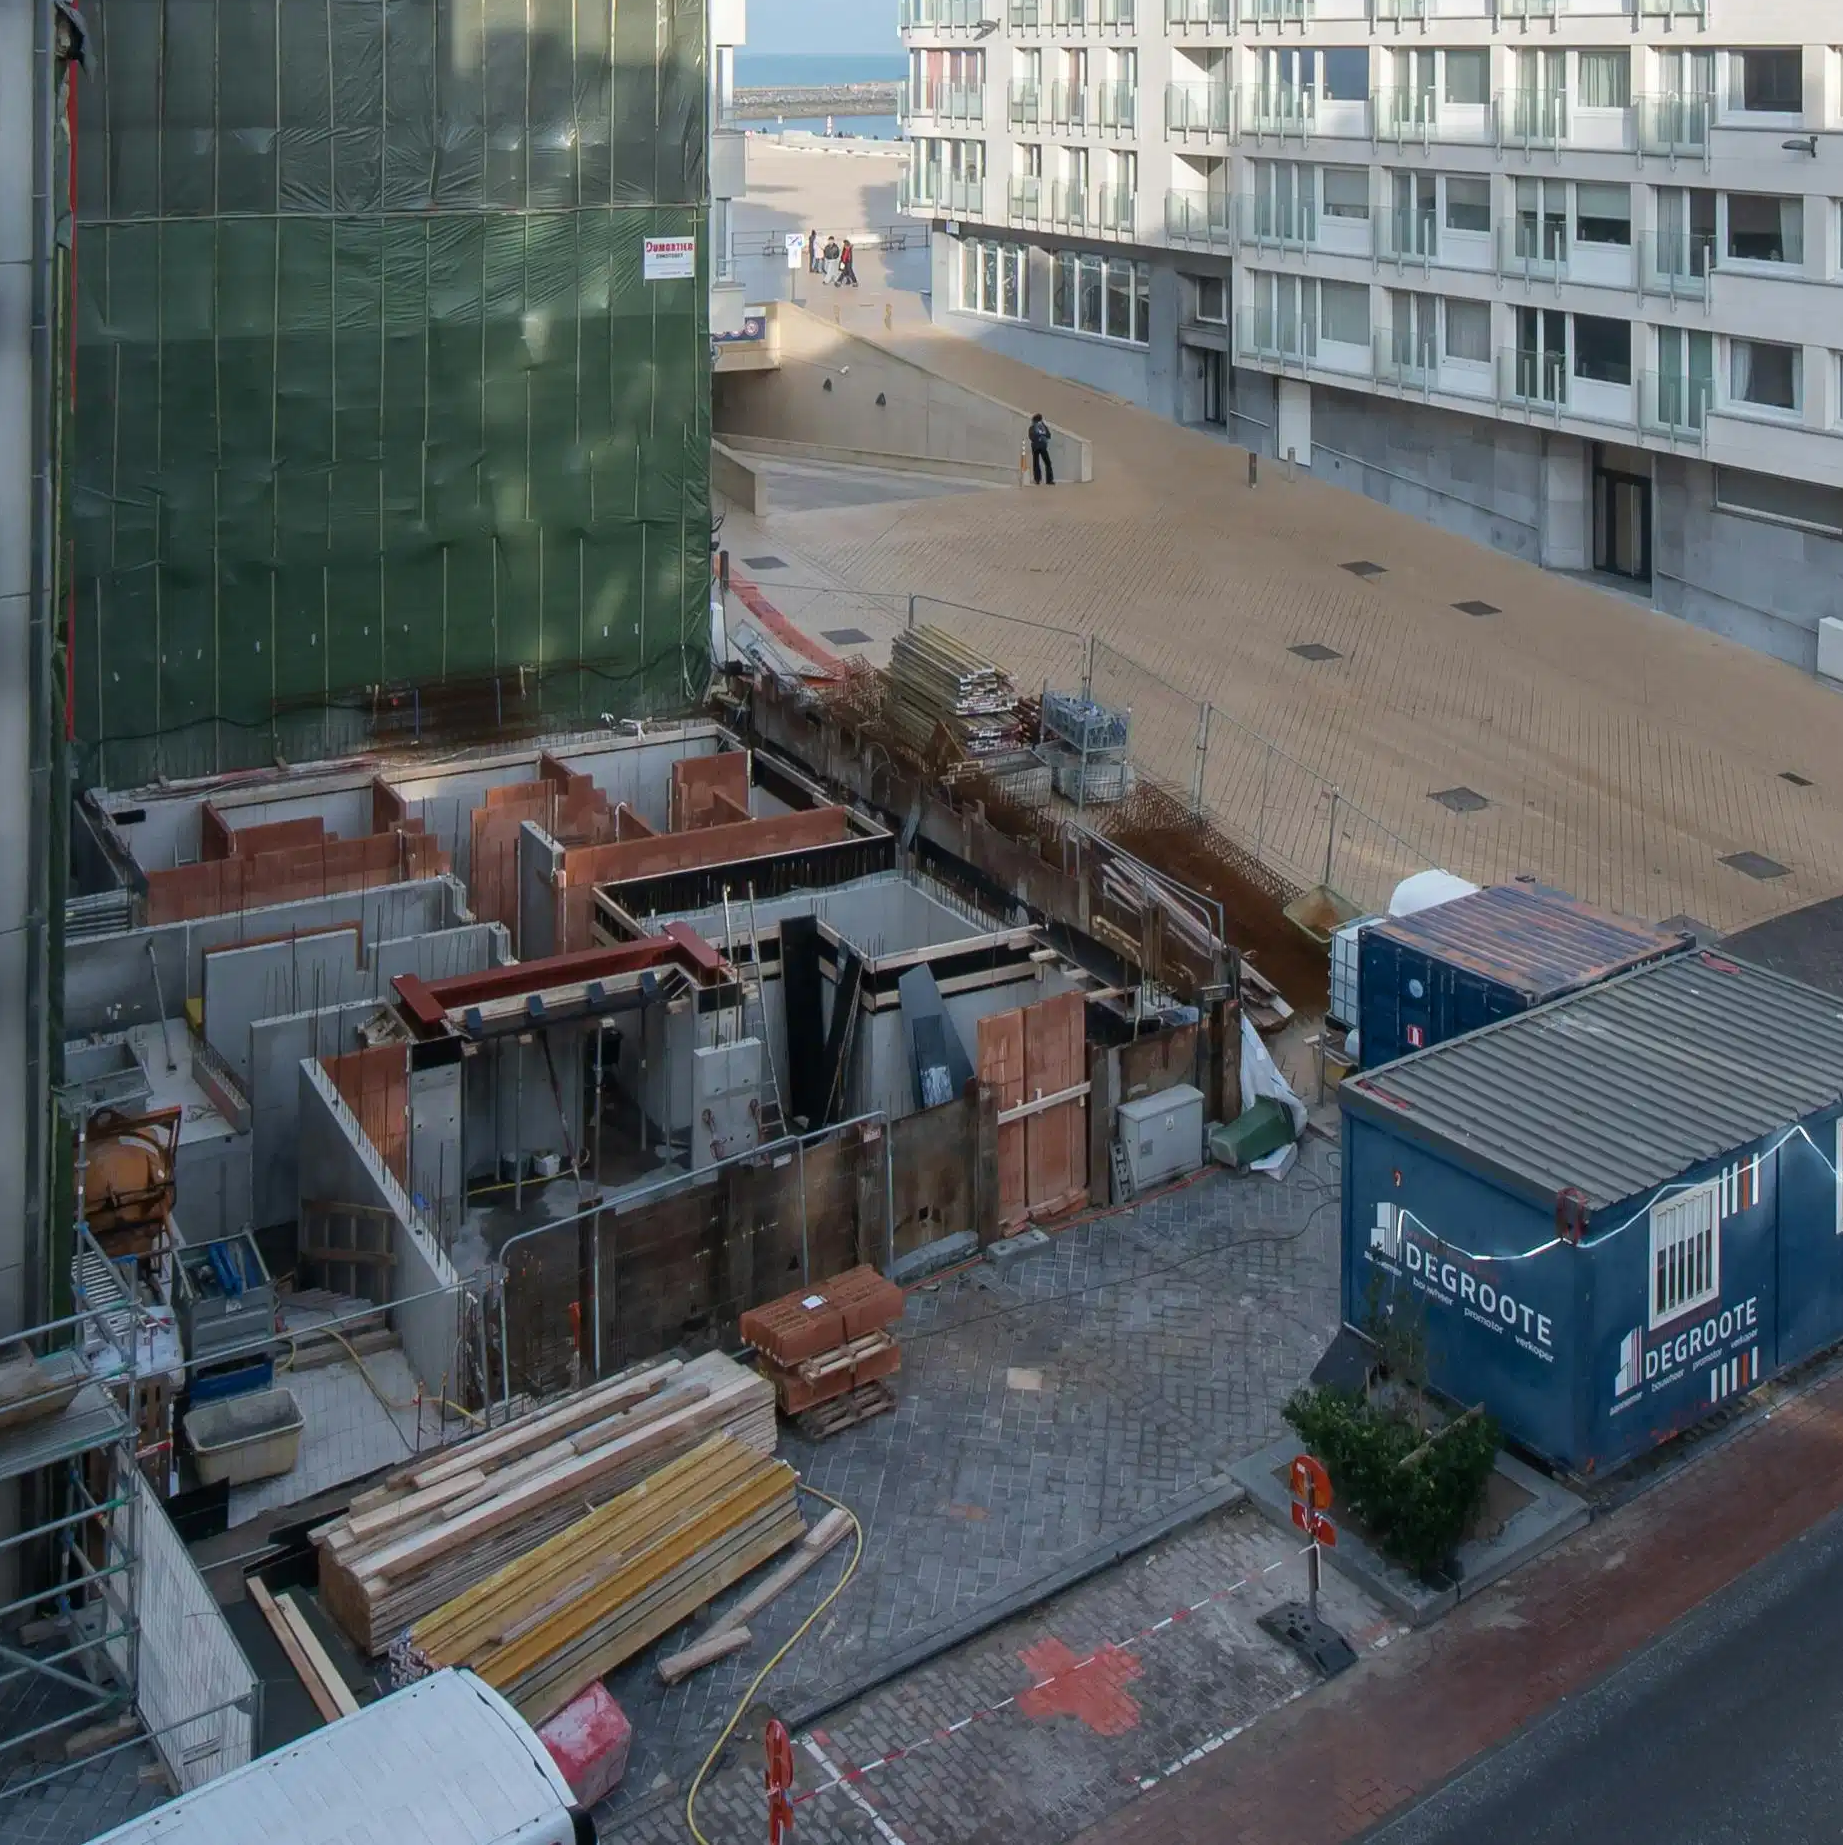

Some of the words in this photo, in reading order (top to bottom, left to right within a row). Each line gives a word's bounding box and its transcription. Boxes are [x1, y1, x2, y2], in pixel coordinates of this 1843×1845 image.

[1406, 1241, 1552, 1346] DEGROOTE
[1464, 1306, 1505, 1335] promotor
[1514, 1335, 1554, 1364] verkoper
[1645, 1296, 1757, 1380] DEGROOTE
